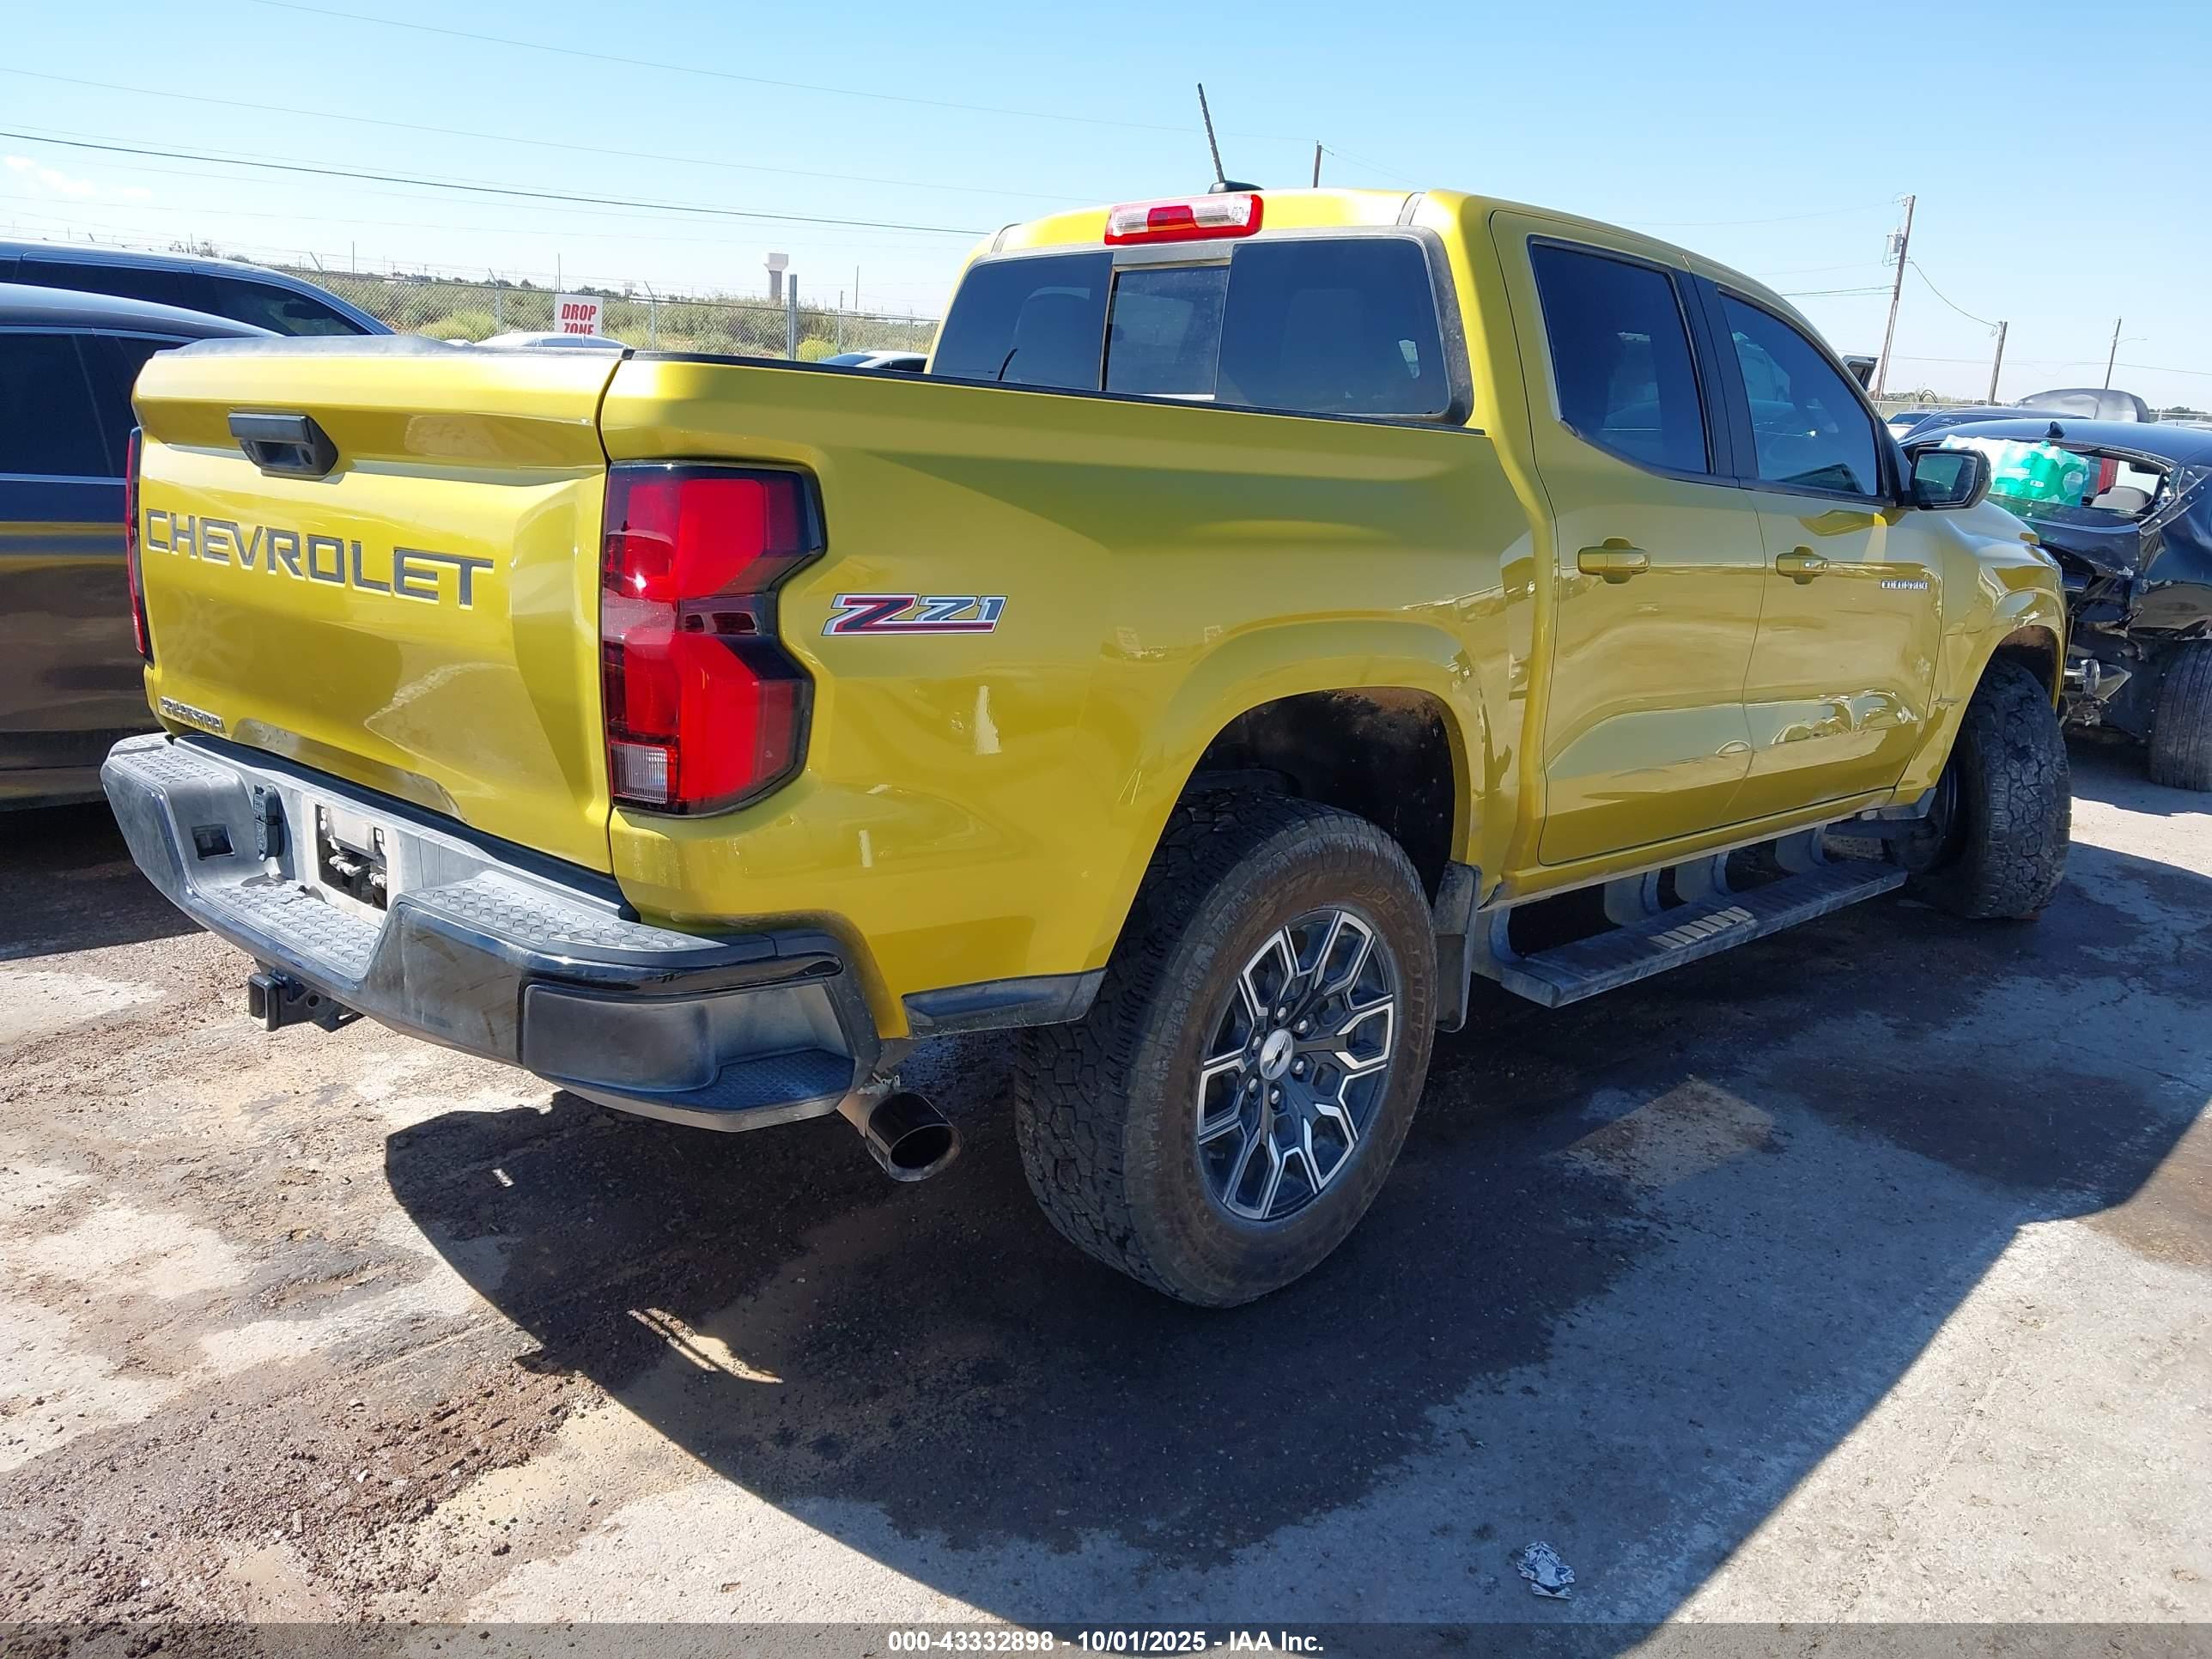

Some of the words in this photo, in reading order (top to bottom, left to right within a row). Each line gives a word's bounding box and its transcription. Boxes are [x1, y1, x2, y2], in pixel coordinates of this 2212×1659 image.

[561, 303, 597, 321] DROP
[563, 322, 594, 335] ZONE
[145, 508, 495, 610] CHEVROLET
[821, 593, 1009, 635] Z71
